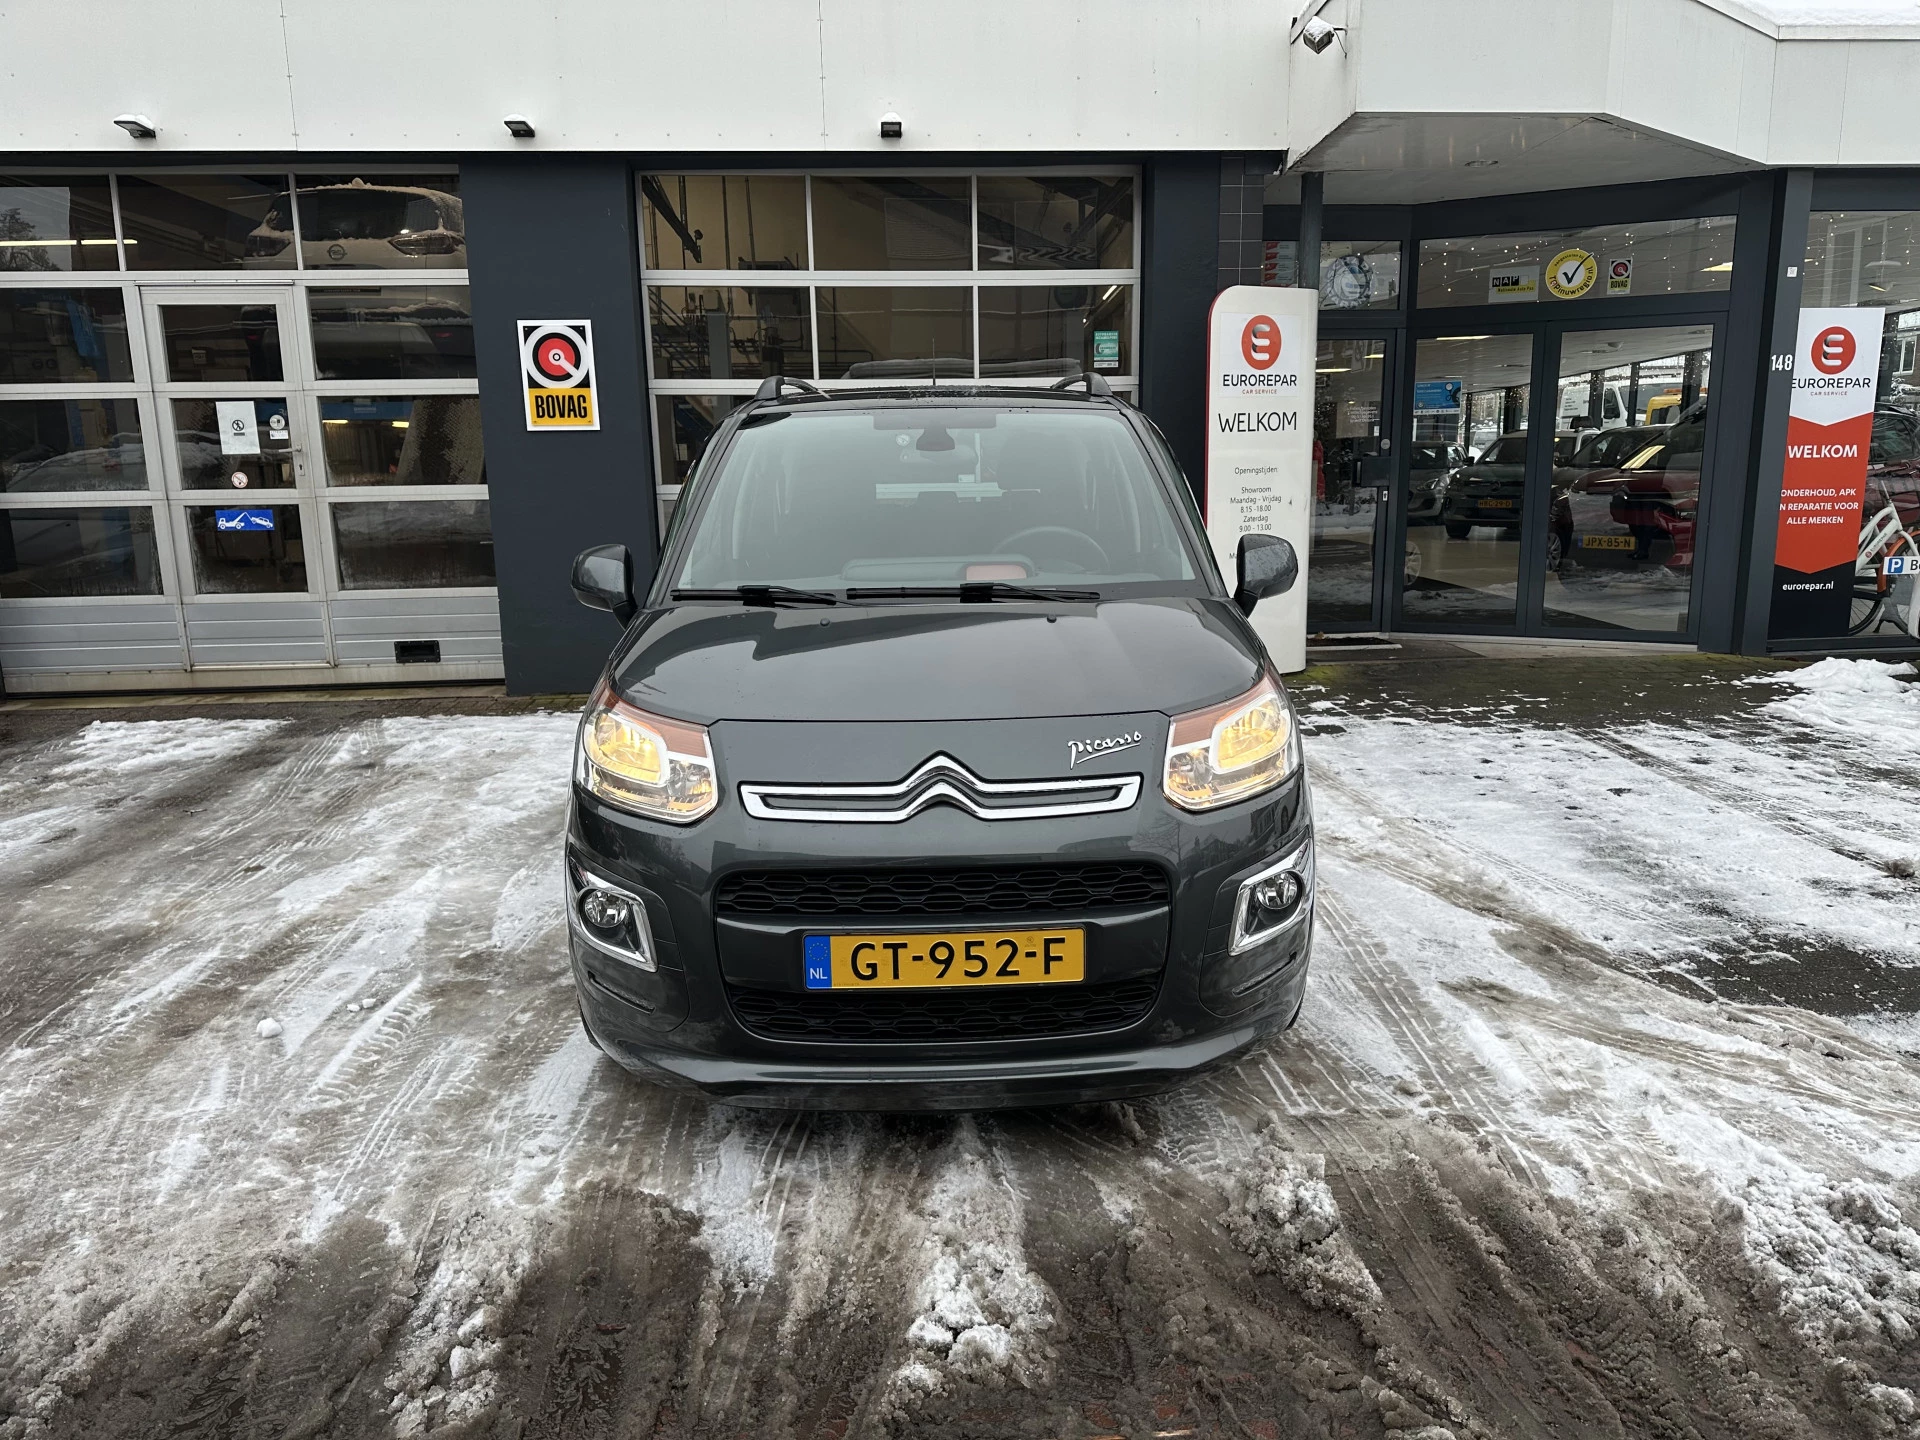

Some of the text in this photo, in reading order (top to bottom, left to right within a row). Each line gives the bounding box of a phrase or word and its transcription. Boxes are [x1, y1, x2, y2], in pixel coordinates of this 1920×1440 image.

[1492, 275, 1520, 287] NAP
[1610, 280, 1628, 288] BOVAG
[1771, 354, 1793, 371] 148
[1223, 374, 1297, 387] EUROREPAR
[1791, 377, 1871, 389] EUROREPAR
[534, 394, 588, 419] BOVAG
[1218, 411, 1297, 433] WELKOM
[1787, 444, 1858, 458] WELKOM
[1241, 486, 1272, 494] Showroom
[1780, 488, 1857, 497] ONDERHOUD, APK
[1230, 496, 1257, 504] Maandag
[1262, 495, 1282, 503] Vrijdag
[1240, 505, 1252, 513] 8.15
[1779, 502, 1859, 511] N REPARATIE VOOR
[1243, 514, 1269, 523] Zaterdag
[1786, 516, 1844, 524] ALLE MERKEN
[1238, 524, 1251, 532] 9.00
[1257, 523, 1272, 531] 13.00
[1585, 536, 1631, 548] JPX-85-N
[1910, 559, 1920, 571] B
[1782, 581, 1834, 591] eurorepar.nl
[810, 936, 1066, 981] NL GT-952-F
